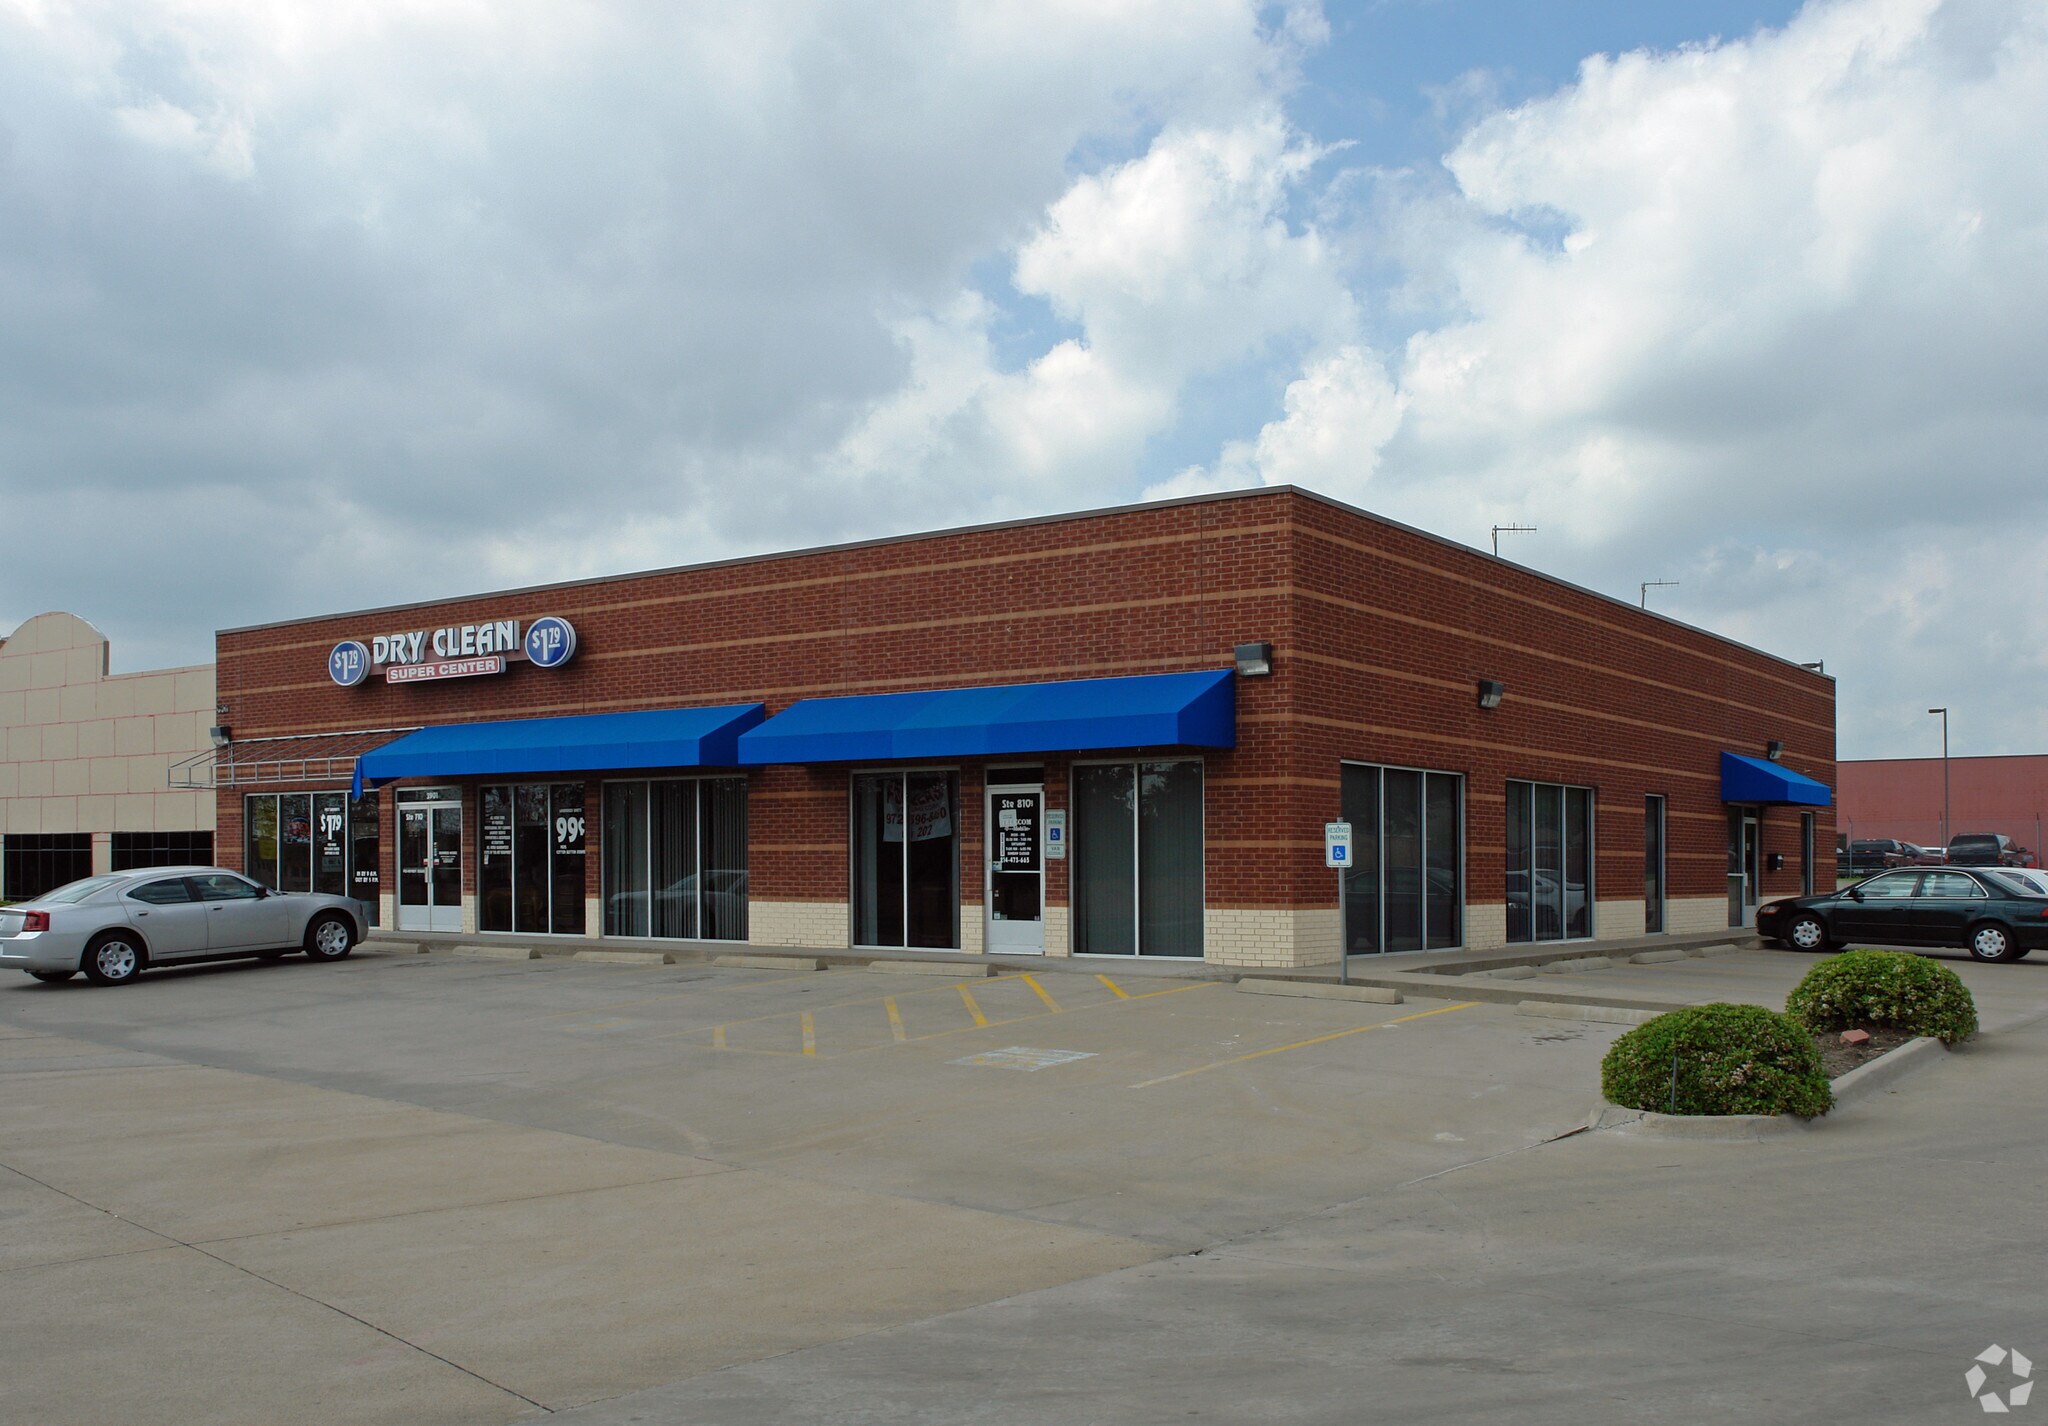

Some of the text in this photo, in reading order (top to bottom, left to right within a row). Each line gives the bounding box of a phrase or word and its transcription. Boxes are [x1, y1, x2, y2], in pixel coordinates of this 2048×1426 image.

[373, 620, 515, 665] DRY CLEAN
[390, 660, 496, 680] SUPER CENTER
[1002, 799, 1014, 808] Ste
[1017, 799, 1030, 808] 810
[415, 813, 424, 821] 710
[556, 816, 585, 843] 99¢
